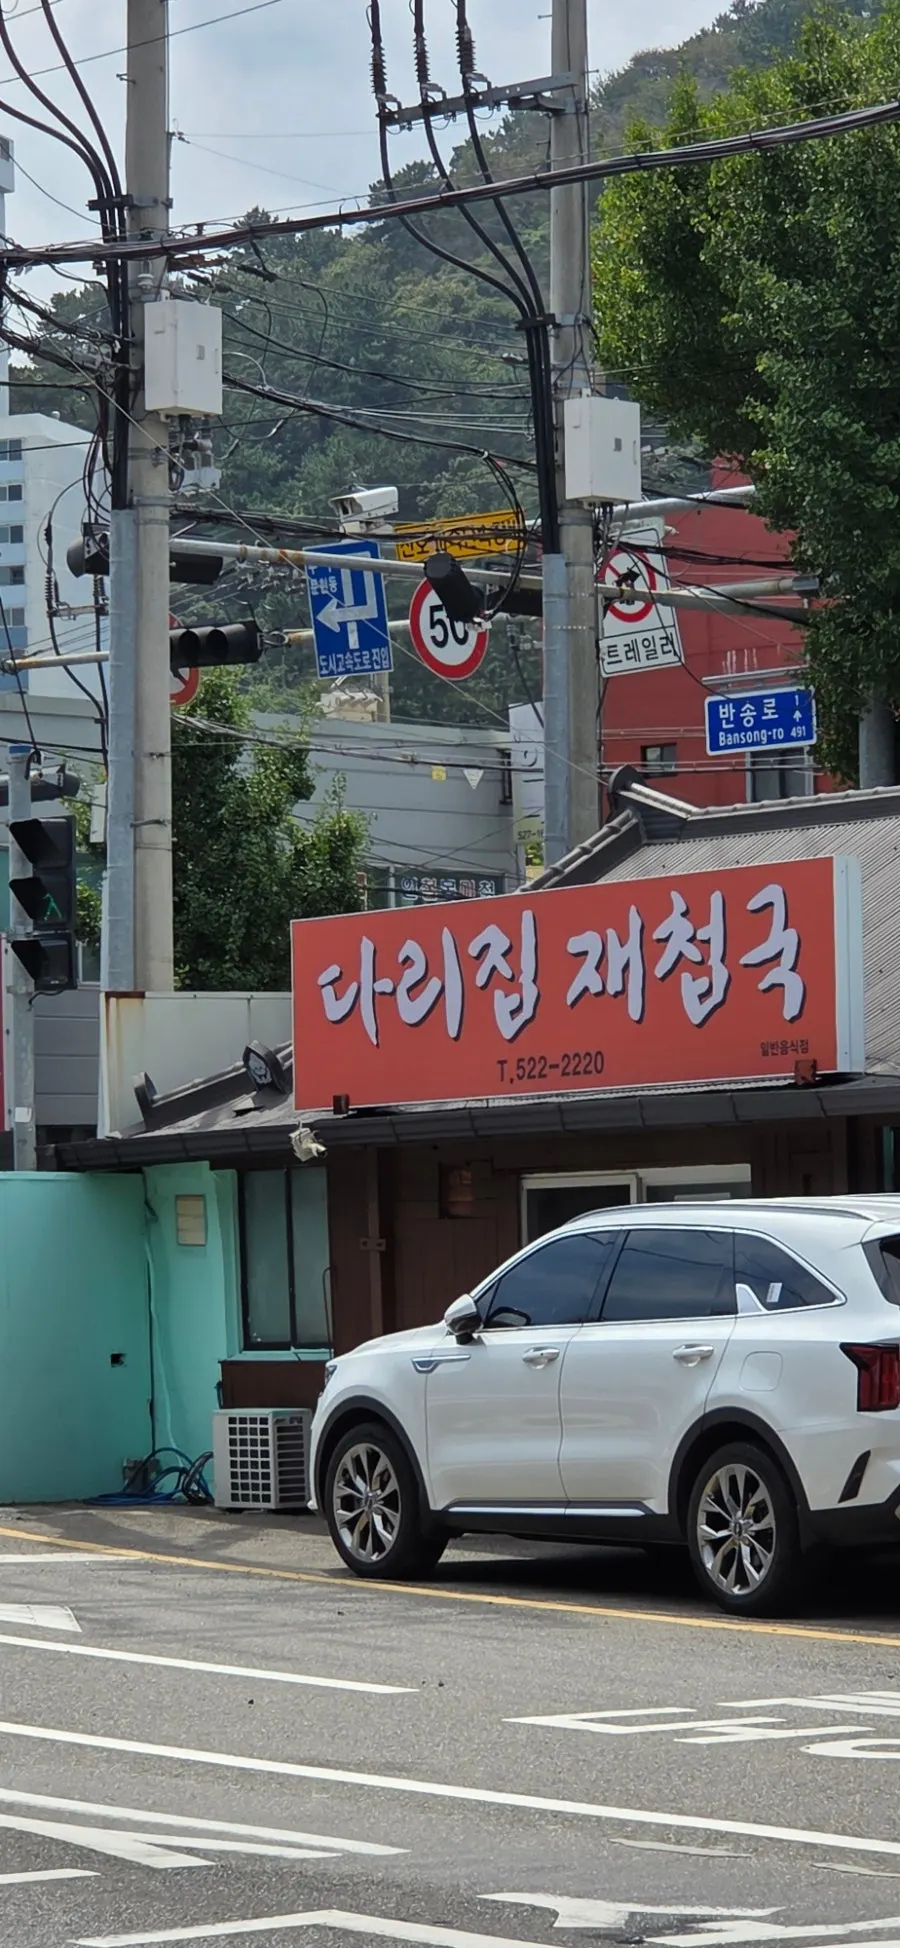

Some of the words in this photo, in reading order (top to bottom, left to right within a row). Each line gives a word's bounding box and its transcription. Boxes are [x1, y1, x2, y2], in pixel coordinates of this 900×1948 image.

[606, 632, 678, 665] 트레일러
[718, 698, 779, 729] 반송로
[719, 728, 785, 747] Bansong-ro
[790, 726, 806, 738] 491
[317, 909, 541, 1048] 다리집
[566, 884, 806, 1028] 재첩국
[760, 1039, 809, 1057] 일반음식점
